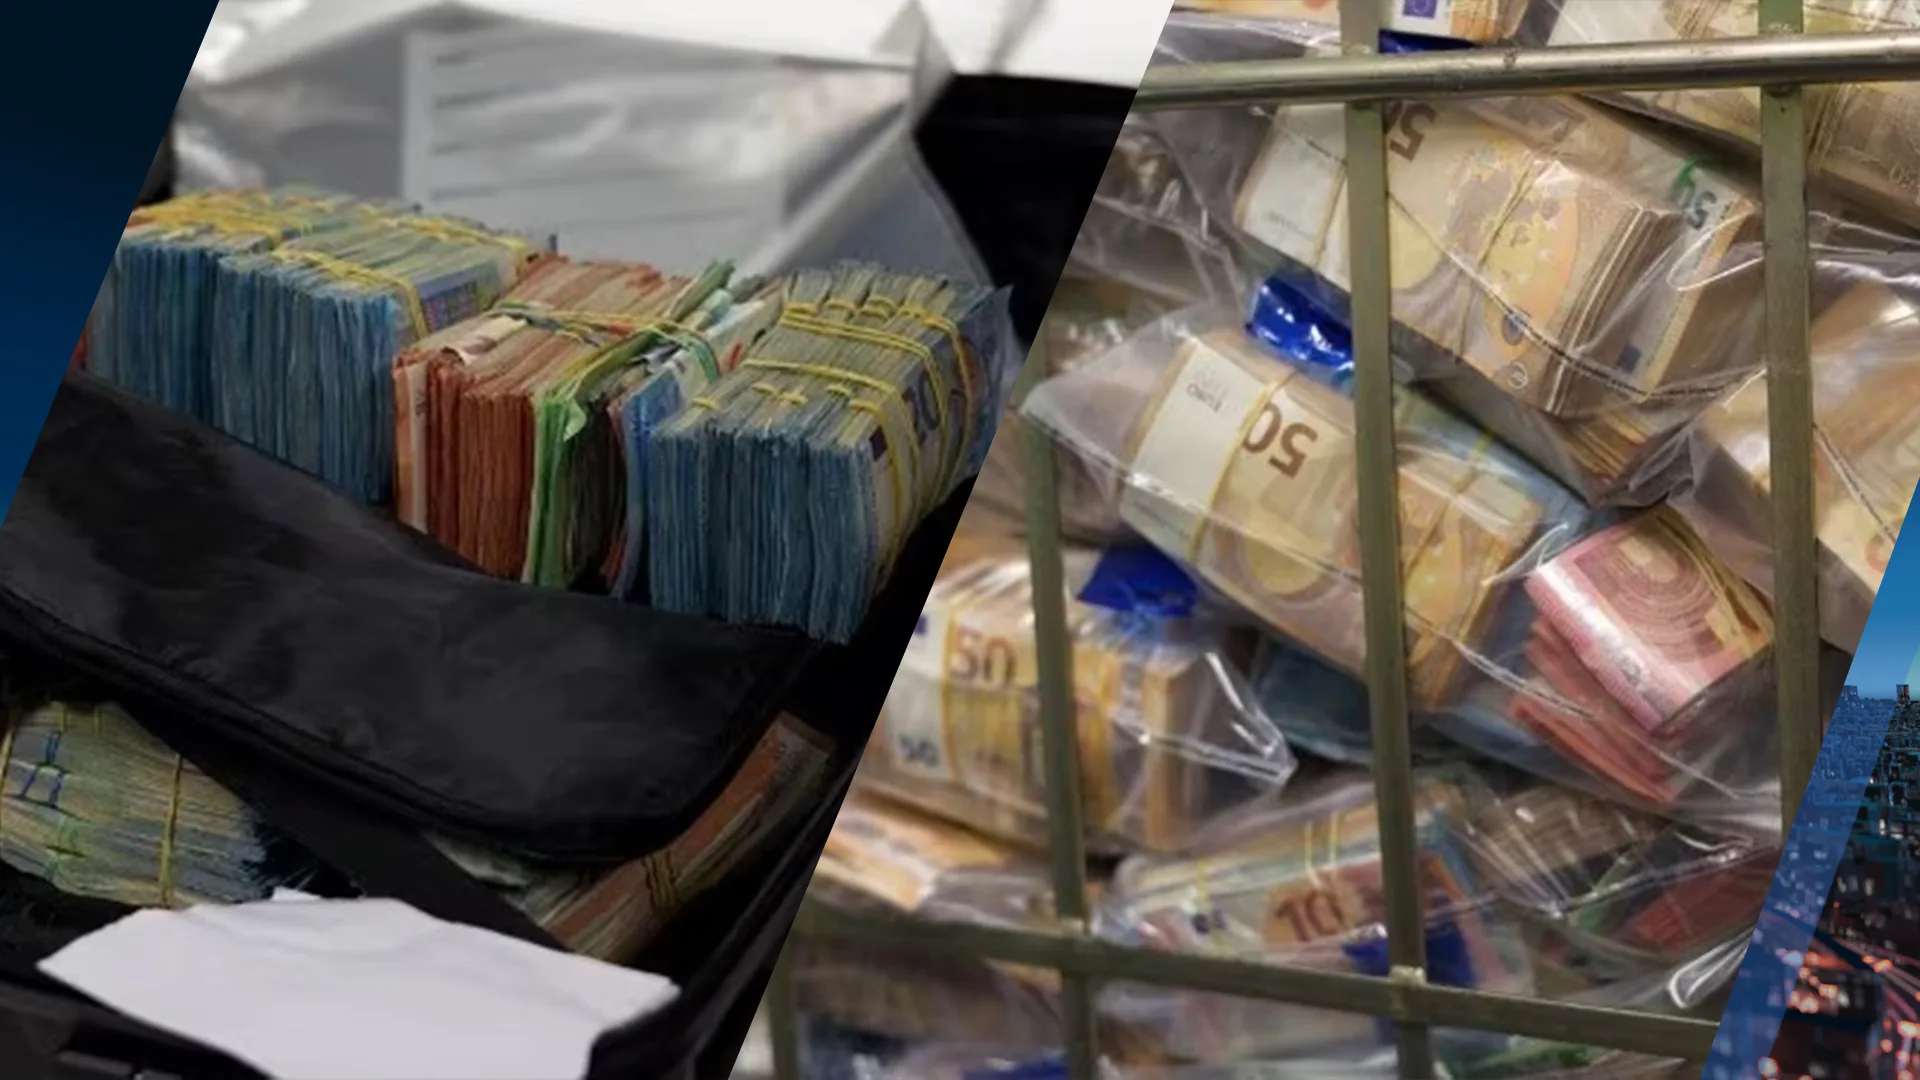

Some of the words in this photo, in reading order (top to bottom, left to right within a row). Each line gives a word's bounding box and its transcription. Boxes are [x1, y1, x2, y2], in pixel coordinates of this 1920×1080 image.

[1241, 402, 1319, 480] 50
[950, 626, 1017, 685] 50
[1275, 889, 1346, 943] 10
